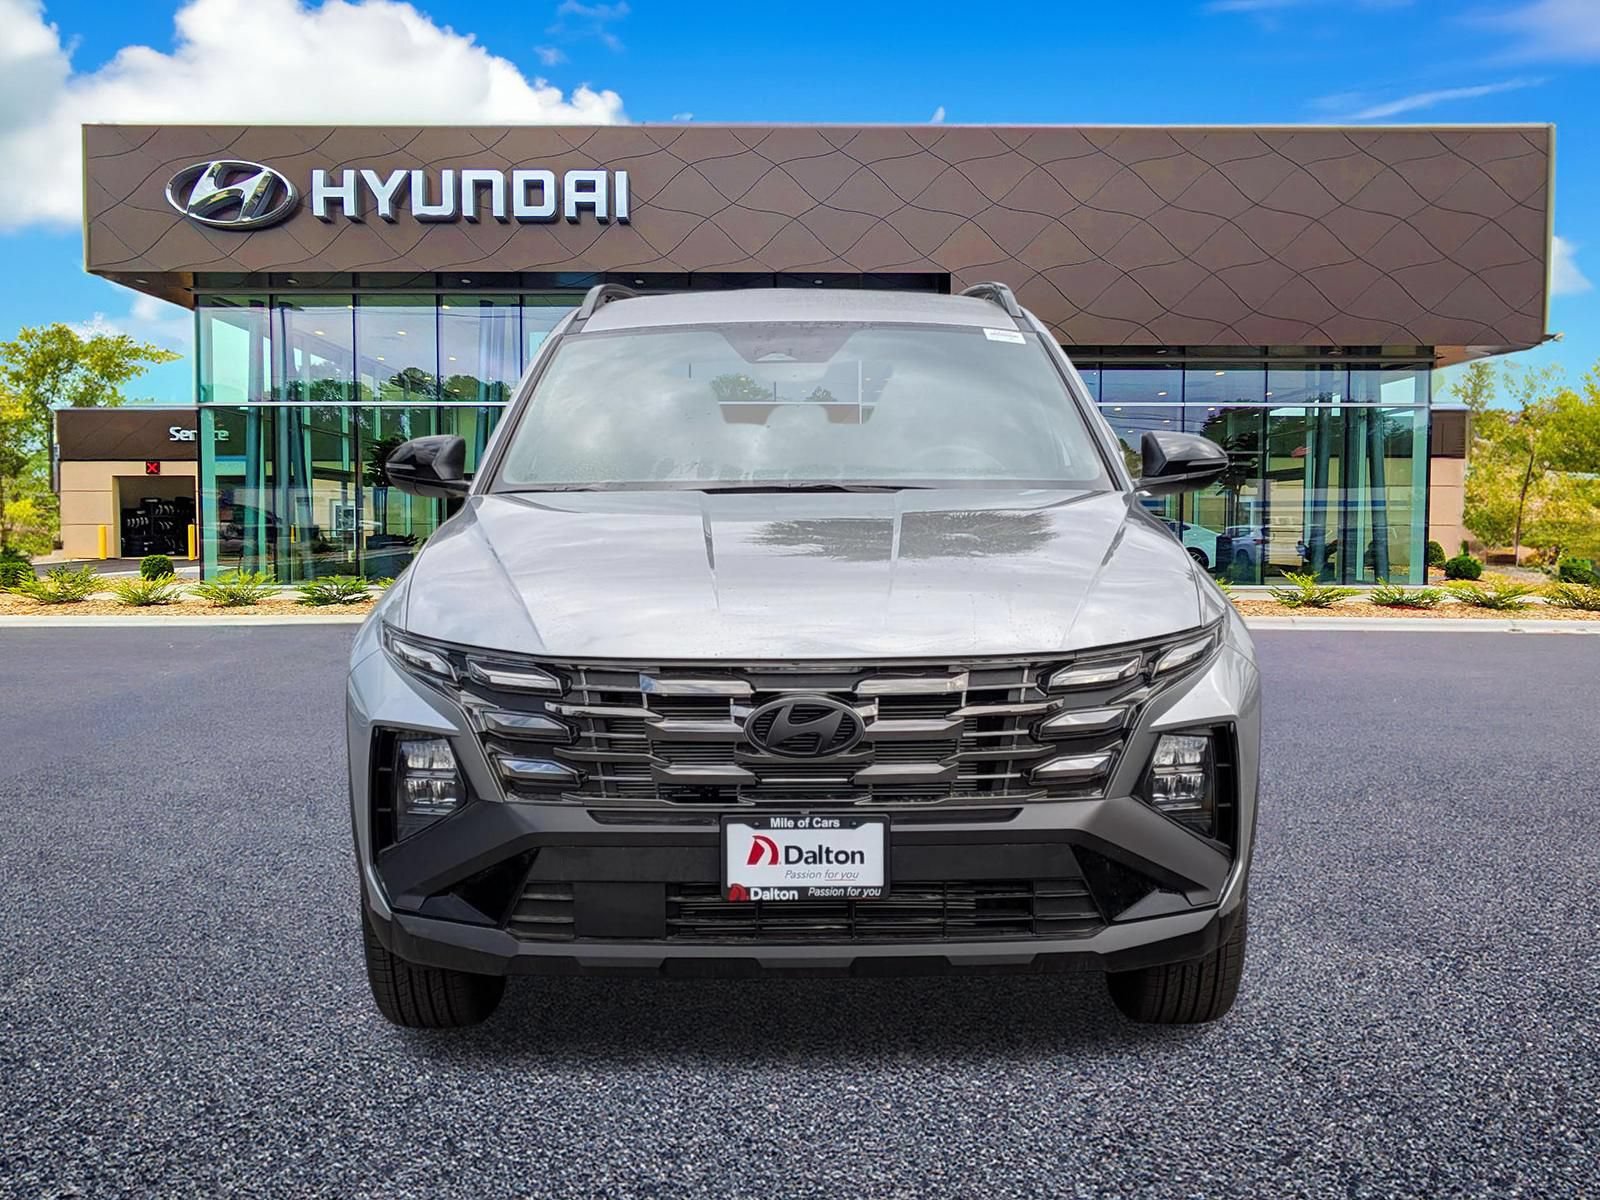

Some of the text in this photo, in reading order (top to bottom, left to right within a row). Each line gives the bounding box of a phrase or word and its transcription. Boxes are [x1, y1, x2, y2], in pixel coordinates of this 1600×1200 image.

[312, 169, 630, 223] HYUNDAI
[770, 817, 841, 828] Mile of Cars
[784, 844, 865, 865] Dalton
[784, 869, 859, 881] Passion for you
[750, 887, 799, 901] Dalton
[808, 886, 882, 899] Passion for you
